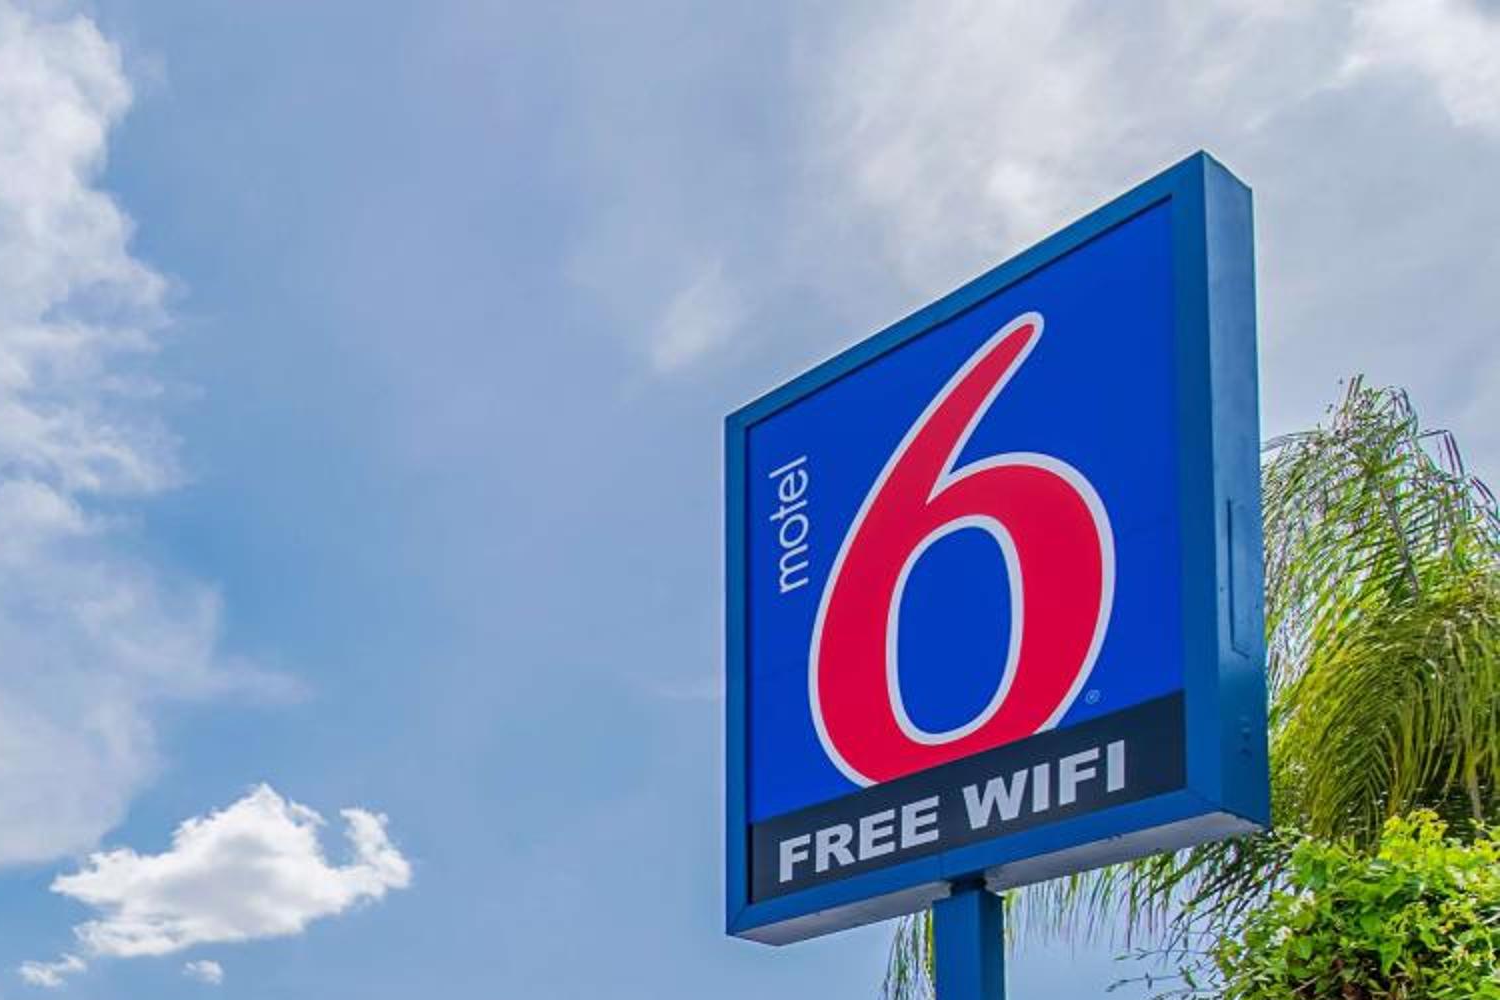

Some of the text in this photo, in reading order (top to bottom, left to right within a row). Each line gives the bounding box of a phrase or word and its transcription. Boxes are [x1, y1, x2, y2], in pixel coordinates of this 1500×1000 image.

[769, 455, 809, 594] motel
[808, 311, 1116, 788] 6
[778, 739, 1126, 884] FREE WIFI
